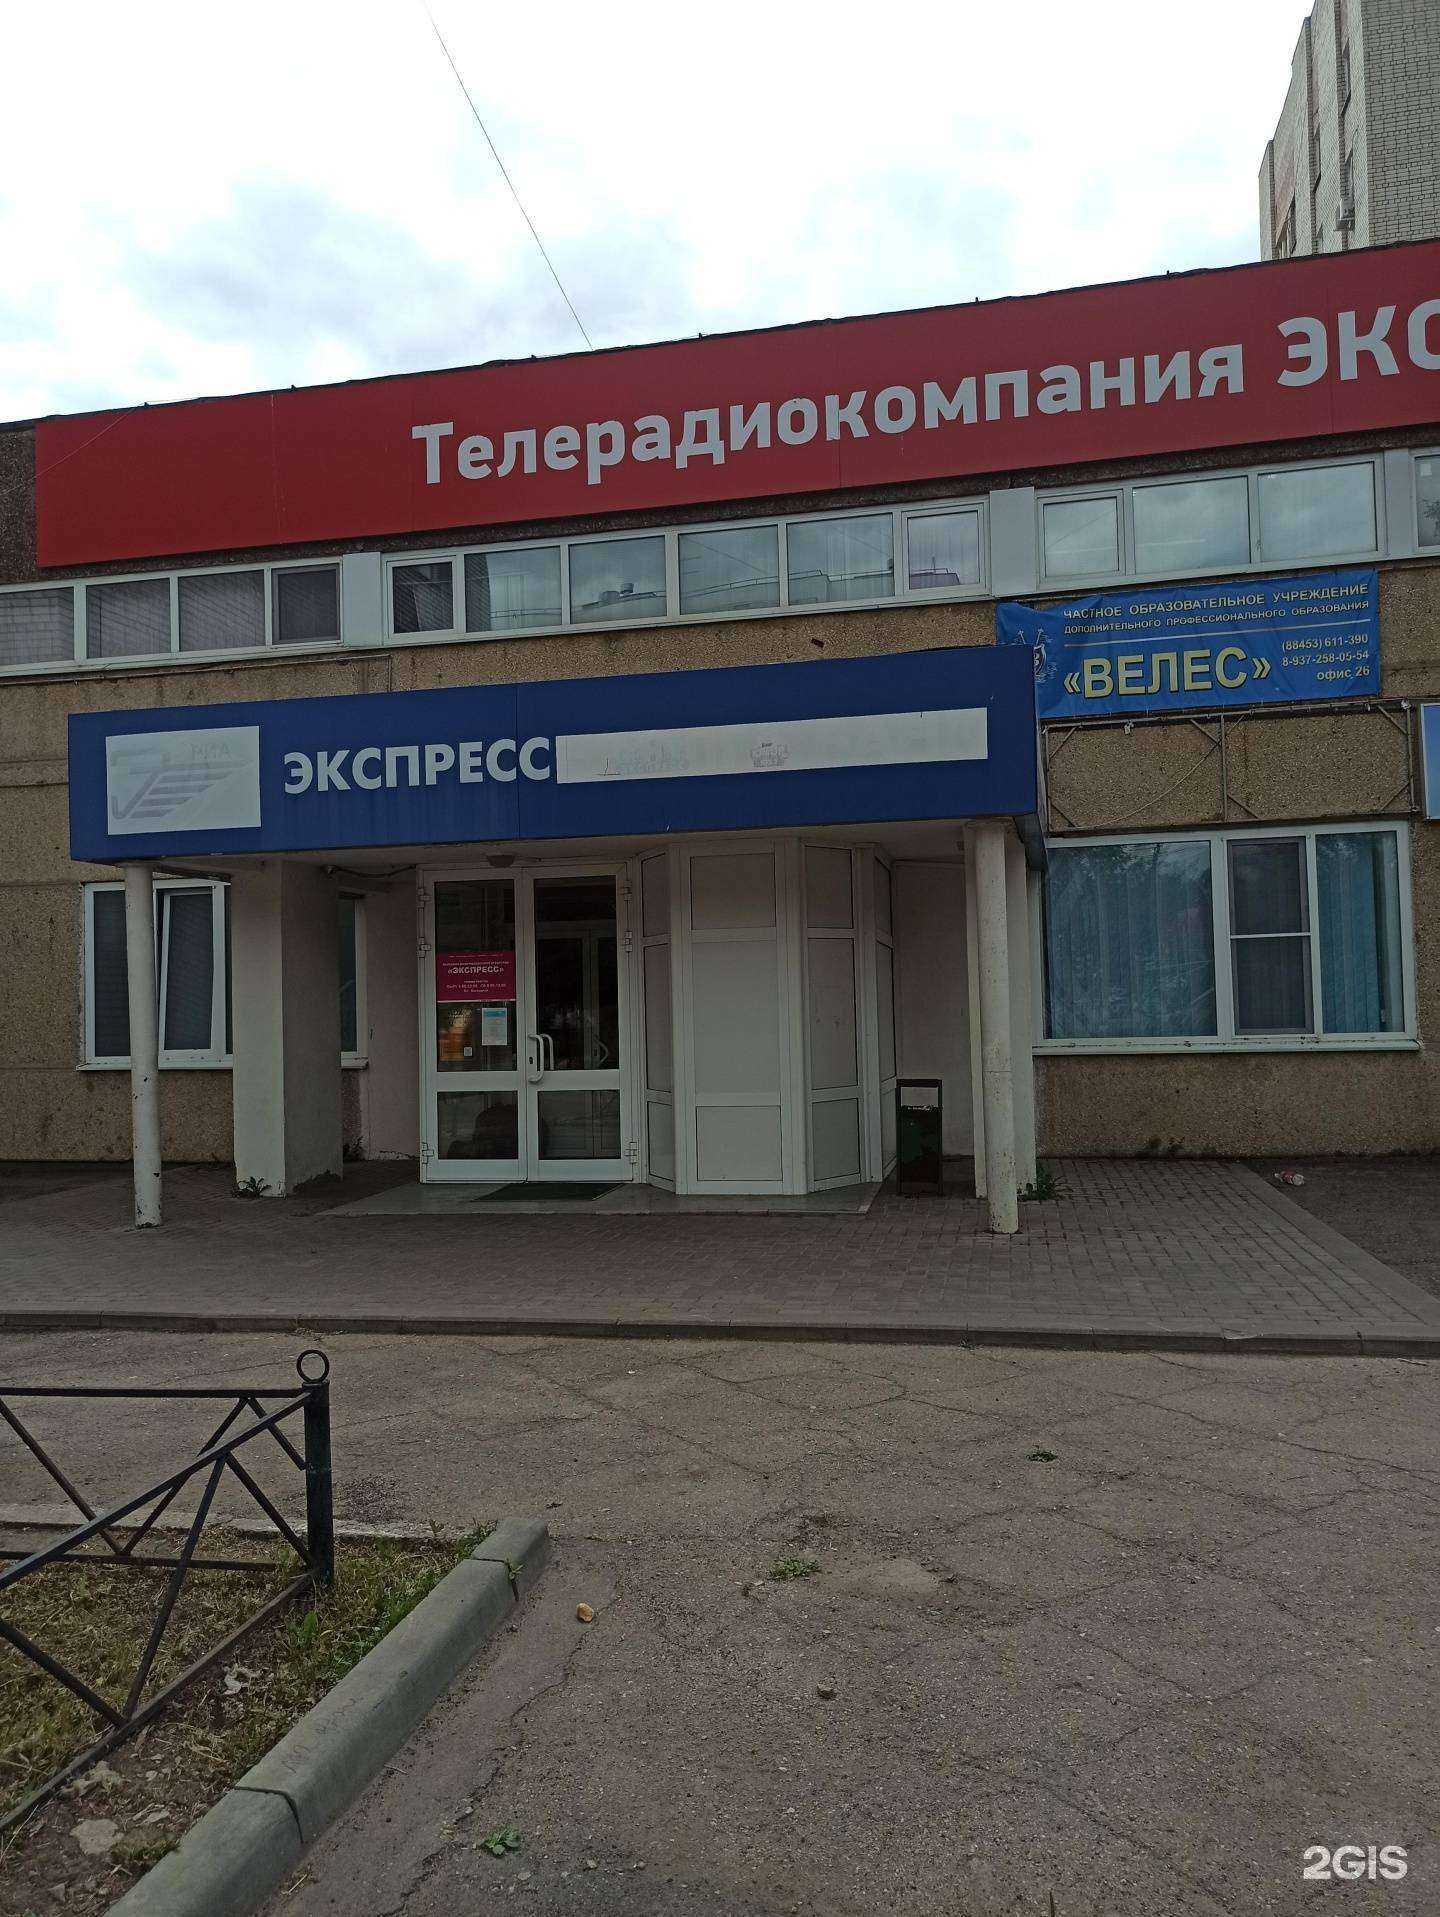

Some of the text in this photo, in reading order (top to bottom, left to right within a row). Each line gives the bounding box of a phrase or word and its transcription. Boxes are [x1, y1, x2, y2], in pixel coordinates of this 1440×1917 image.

[411, 299, 1440, 486] Телерадиокомпания ЭКС
[1063, 583, 1369, 620] ЧАСТНОЕ ОБРАЗОВАТЕЛЬНОЕ УЧРЕЖДЕНИЕ
[1064, 600, 1369, 635] ДОПОЛНИТЕЛЬНОГО ПРОФЕССИОНАЛЬНОГО ОБРАЗОВАНИЯ
[1063, 646, 1271, 699] «ВЕЛЕС»
[1317, 664, 1370, 682] офис 26
[283, 736, 550, 795] ЭКСПРЕСС
